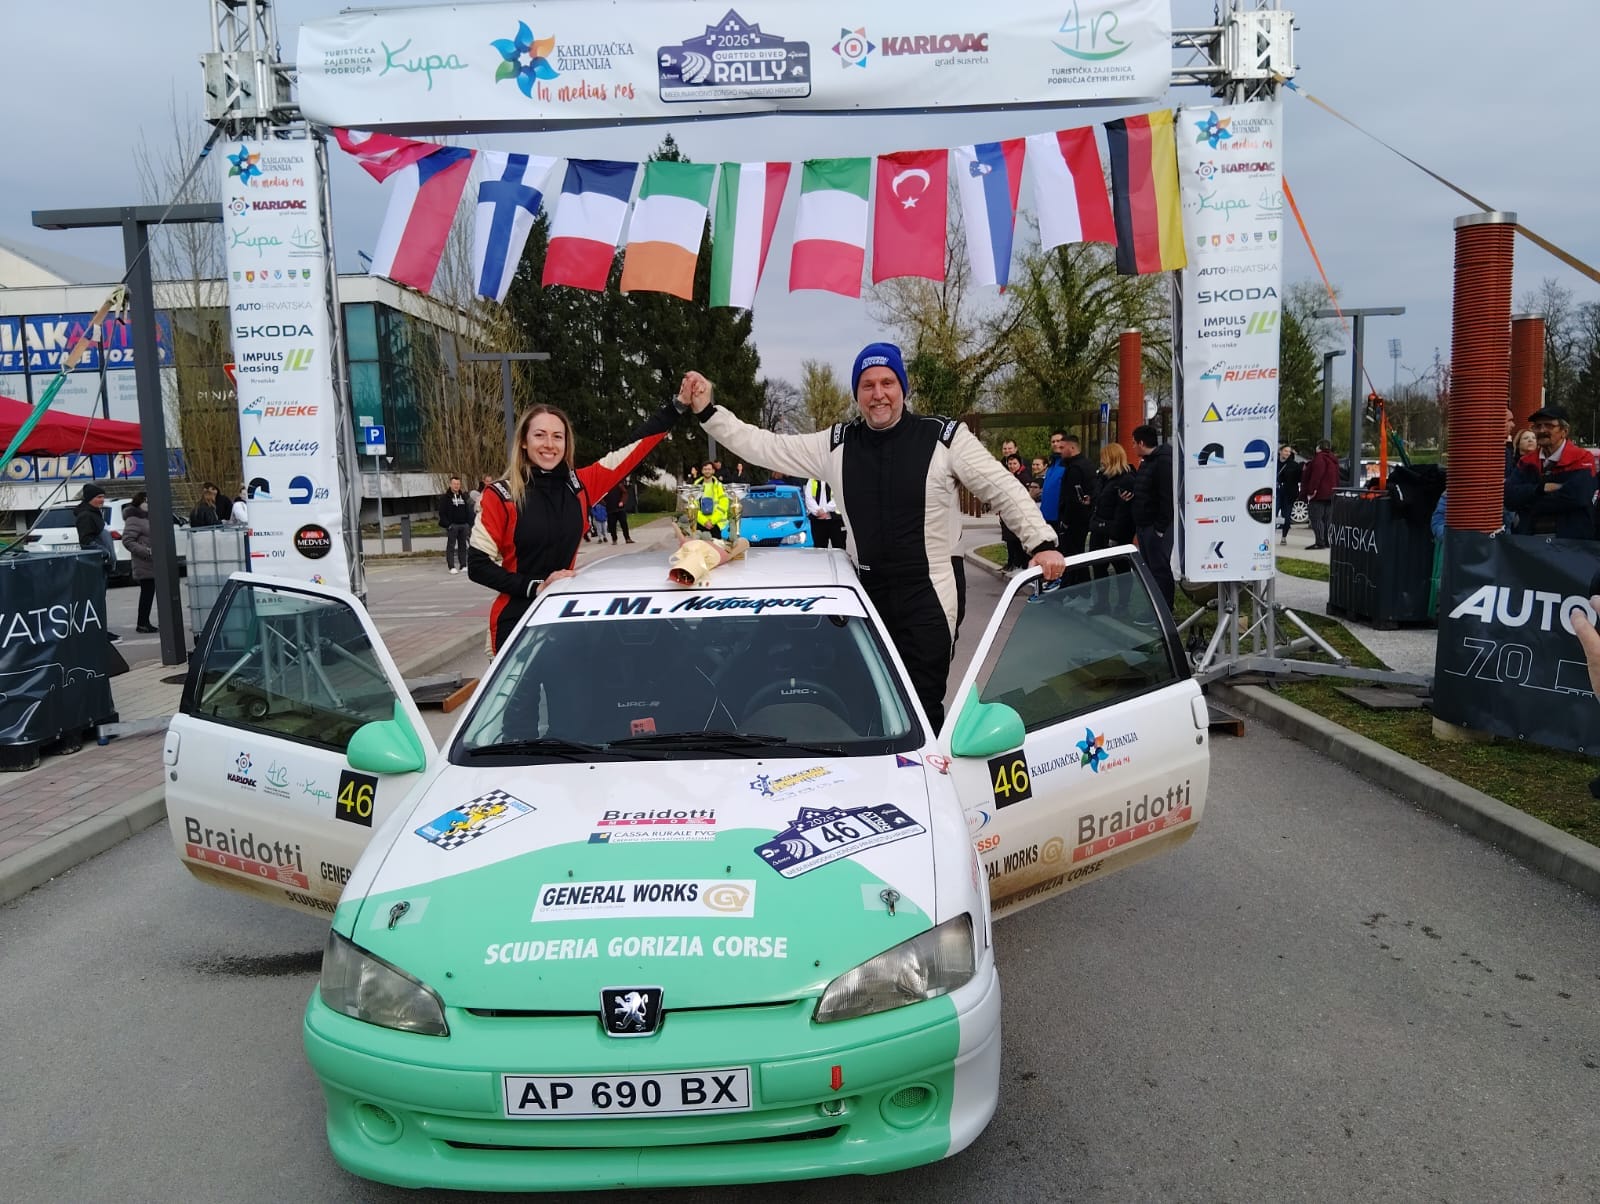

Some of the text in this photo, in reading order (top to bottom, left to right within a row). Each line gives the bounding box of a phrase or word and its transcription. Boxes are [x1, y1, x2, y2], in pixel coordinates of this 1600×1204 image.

[717, 34, 749, 47] 2026
[881, 32, 989, 56] KARLOVAC
[324, 47, 377, 57] TURISTIČKA
[557, 42, 635, 58] KARLOVAČKA
[714, 50, 757, 61] QUATTRO
[324, 57, 374, 67] ZAJEDNICA
[378, 38, 469, 91] Kupa
[557, 57, 612, 71] ŽUPANIJA
[934, 55, 989, 67] grad susreta
[324, 65, 372, 76] PODRUČJA
[714, 60, 788, 83] RALLY
[1051, 65, 1132, 75] TURISTIČKA ZAJEDNICA
[1047, 76, 1086, 85] PODRUČJA
[536, 79, 636, 103] In medias res
[1221, 161, 1276, 173] KARLOVAC
[252, 200, 308, 211] KARLOVAC
[1195, 189, 1251, 223] Kupa
[230, 226, 283, 259] Kupa
[1197, 263, 1278, 277] AUTOHRVATSKA
[234, 301, 314, 312] AUTOHRVATSKA
[1203, 315, 1247, 327] IMPULS
[1198, 327, 1241, 339] Leasing
[47, 349, 92, 365] VAE
[242, 351, 284, 362] IMPULS
[238, 363, 280, 375] Leasing
[1223, 367, 1278, 382] RIJEKE
[264, 405, 320, 417] RIJEKE
[1225, 402, 1276, 420] timing
[370, 429, 380, 441] P
[268, 439, 320, 456] timing
[558, 595, 838, 618] L.M. Motorsport
[1449, 584, 1599, 637] AUTO
[1030, 751, 1081, 778] KARLOVAČKA
[226, 773, 257, 788] KARLOVAC
[994, 759, 1030, 798] 46
[337, 779, 374, 818] 46
[602, 809, 716, 821] Braidotti
[1078, 780, 1191, 845] Braidotti
[806, 814, 836, 828] 2026
[613, 831, 650, 839] CASSA
[652, 830, 691, 838] RURALE
[820, 821, 861, 843] 46
[1084, 821, 1156, 856] MOTO
[185, 816, 304, 873] Braidotti
[196, 847, 269, 877] MOTO
[1003, 844, 1039, 875] WORKS
[1067, 859, 1105, 882] CORSE
[543, 885, 626, 907] GENERAL
[633, 883, 699, 902] WORKS
[484, 936, 788, 965] SCUDERIA GORIZIA CORSE
[518, 1074, 739, 1110] AP 690 BX
